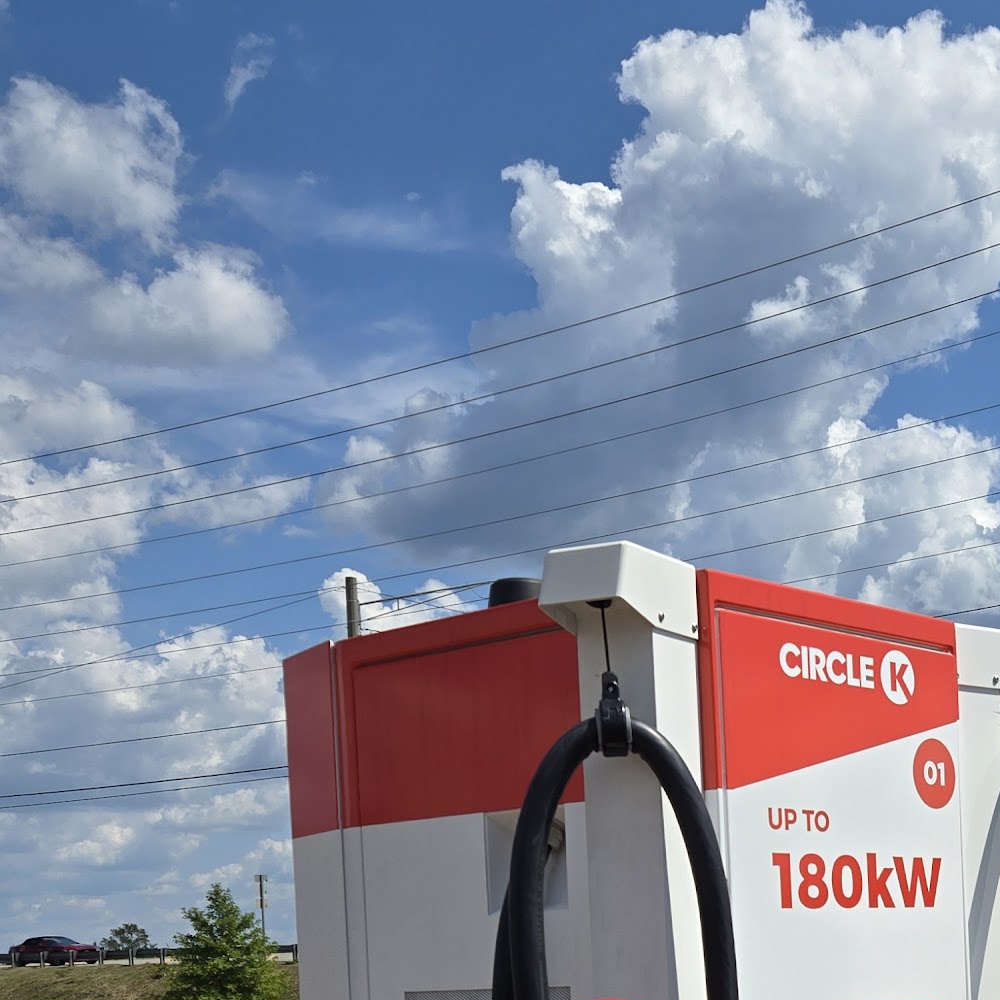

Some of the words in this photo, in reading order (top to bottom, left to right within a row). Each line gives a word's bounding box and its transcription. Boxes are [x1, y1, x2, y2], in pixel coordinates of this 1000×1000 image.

[778, 642, 875, 690] CIRCLE
[885, 655, 914, 704] K
[923, 761, 946, 786] 01
[768, 807, 796, 830] UP
[802, 810, 829, 832] TO
[772, 852, 942, 909] 180kW
